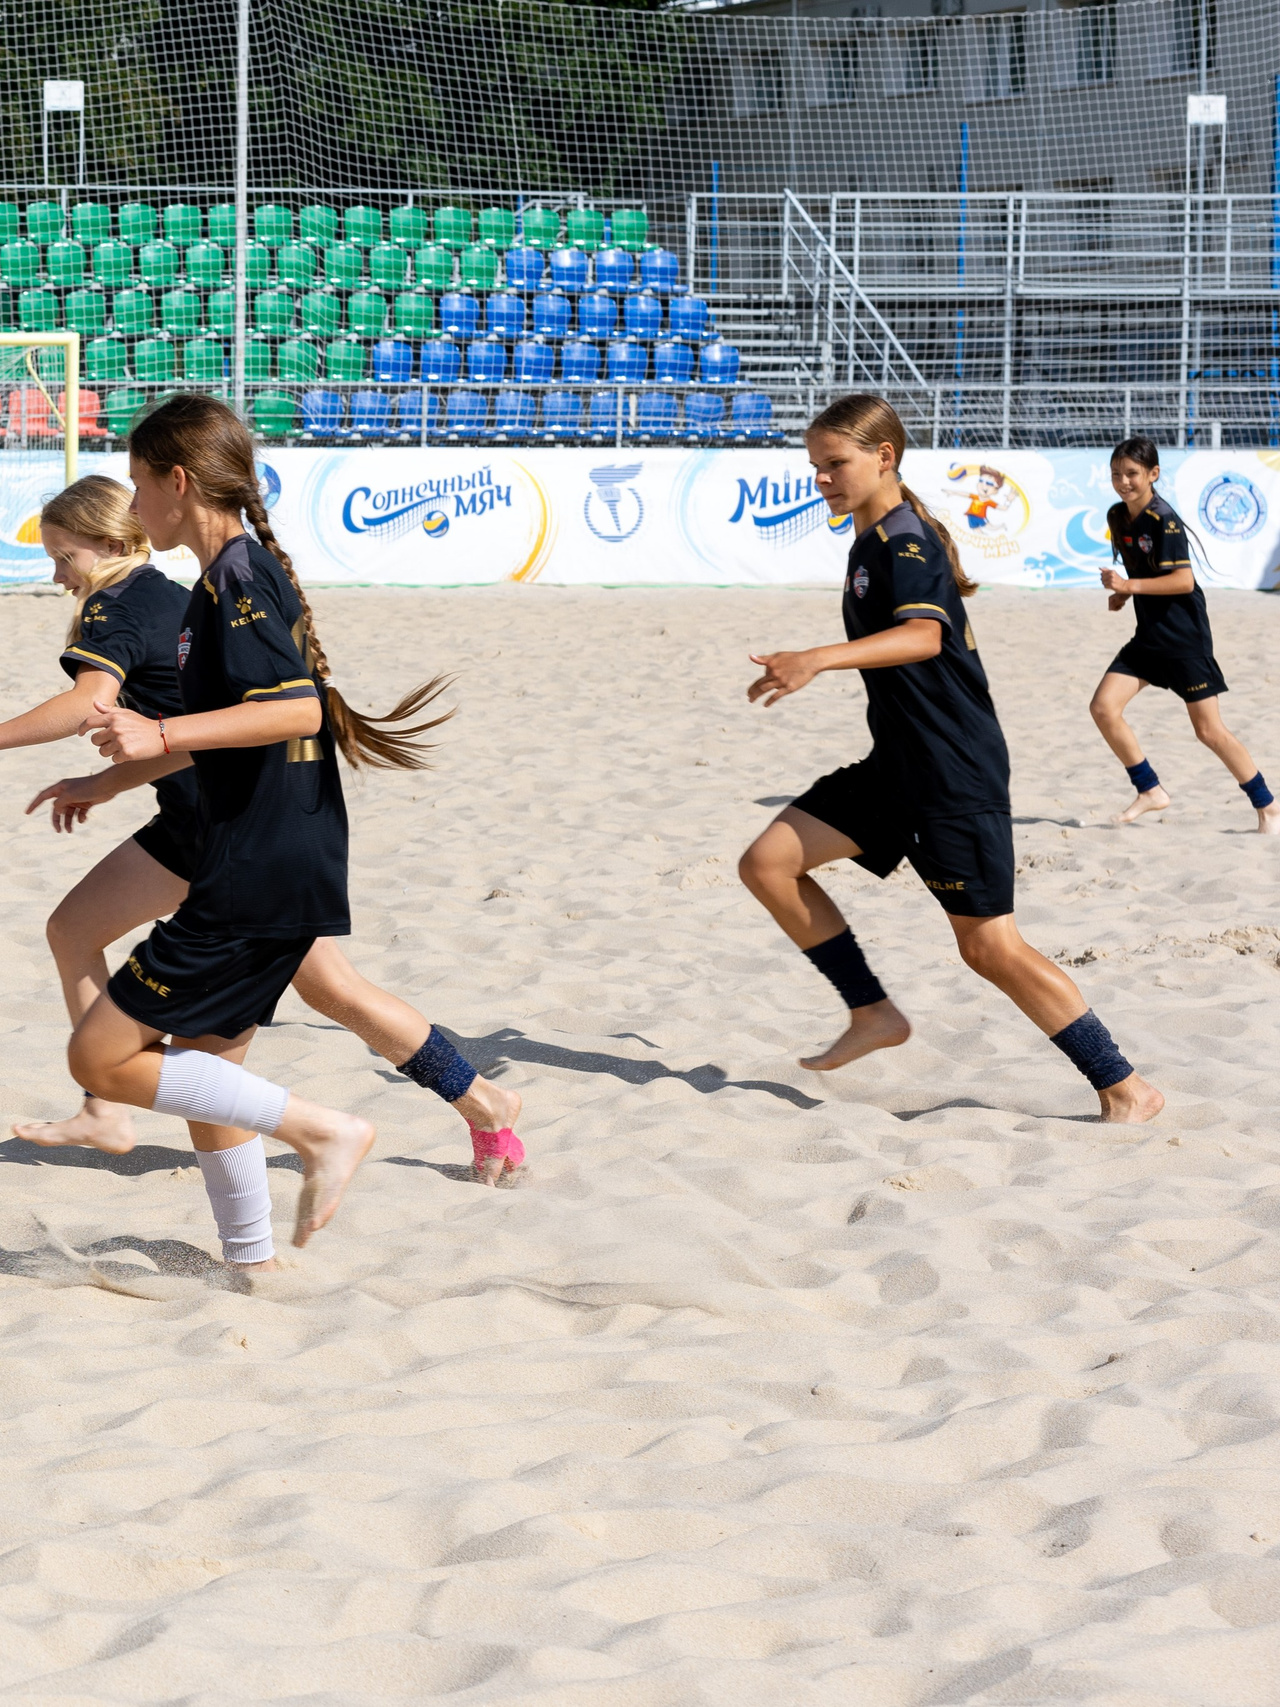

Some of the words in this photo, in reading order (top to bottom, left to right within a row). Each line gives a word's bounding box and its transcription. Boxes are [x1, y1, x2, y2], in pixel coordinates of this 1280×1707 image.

[342, 464, 492, 534] Солнечный
[230, 611, 268, 628] KELME
[925, 880, 965, 891] KELME
